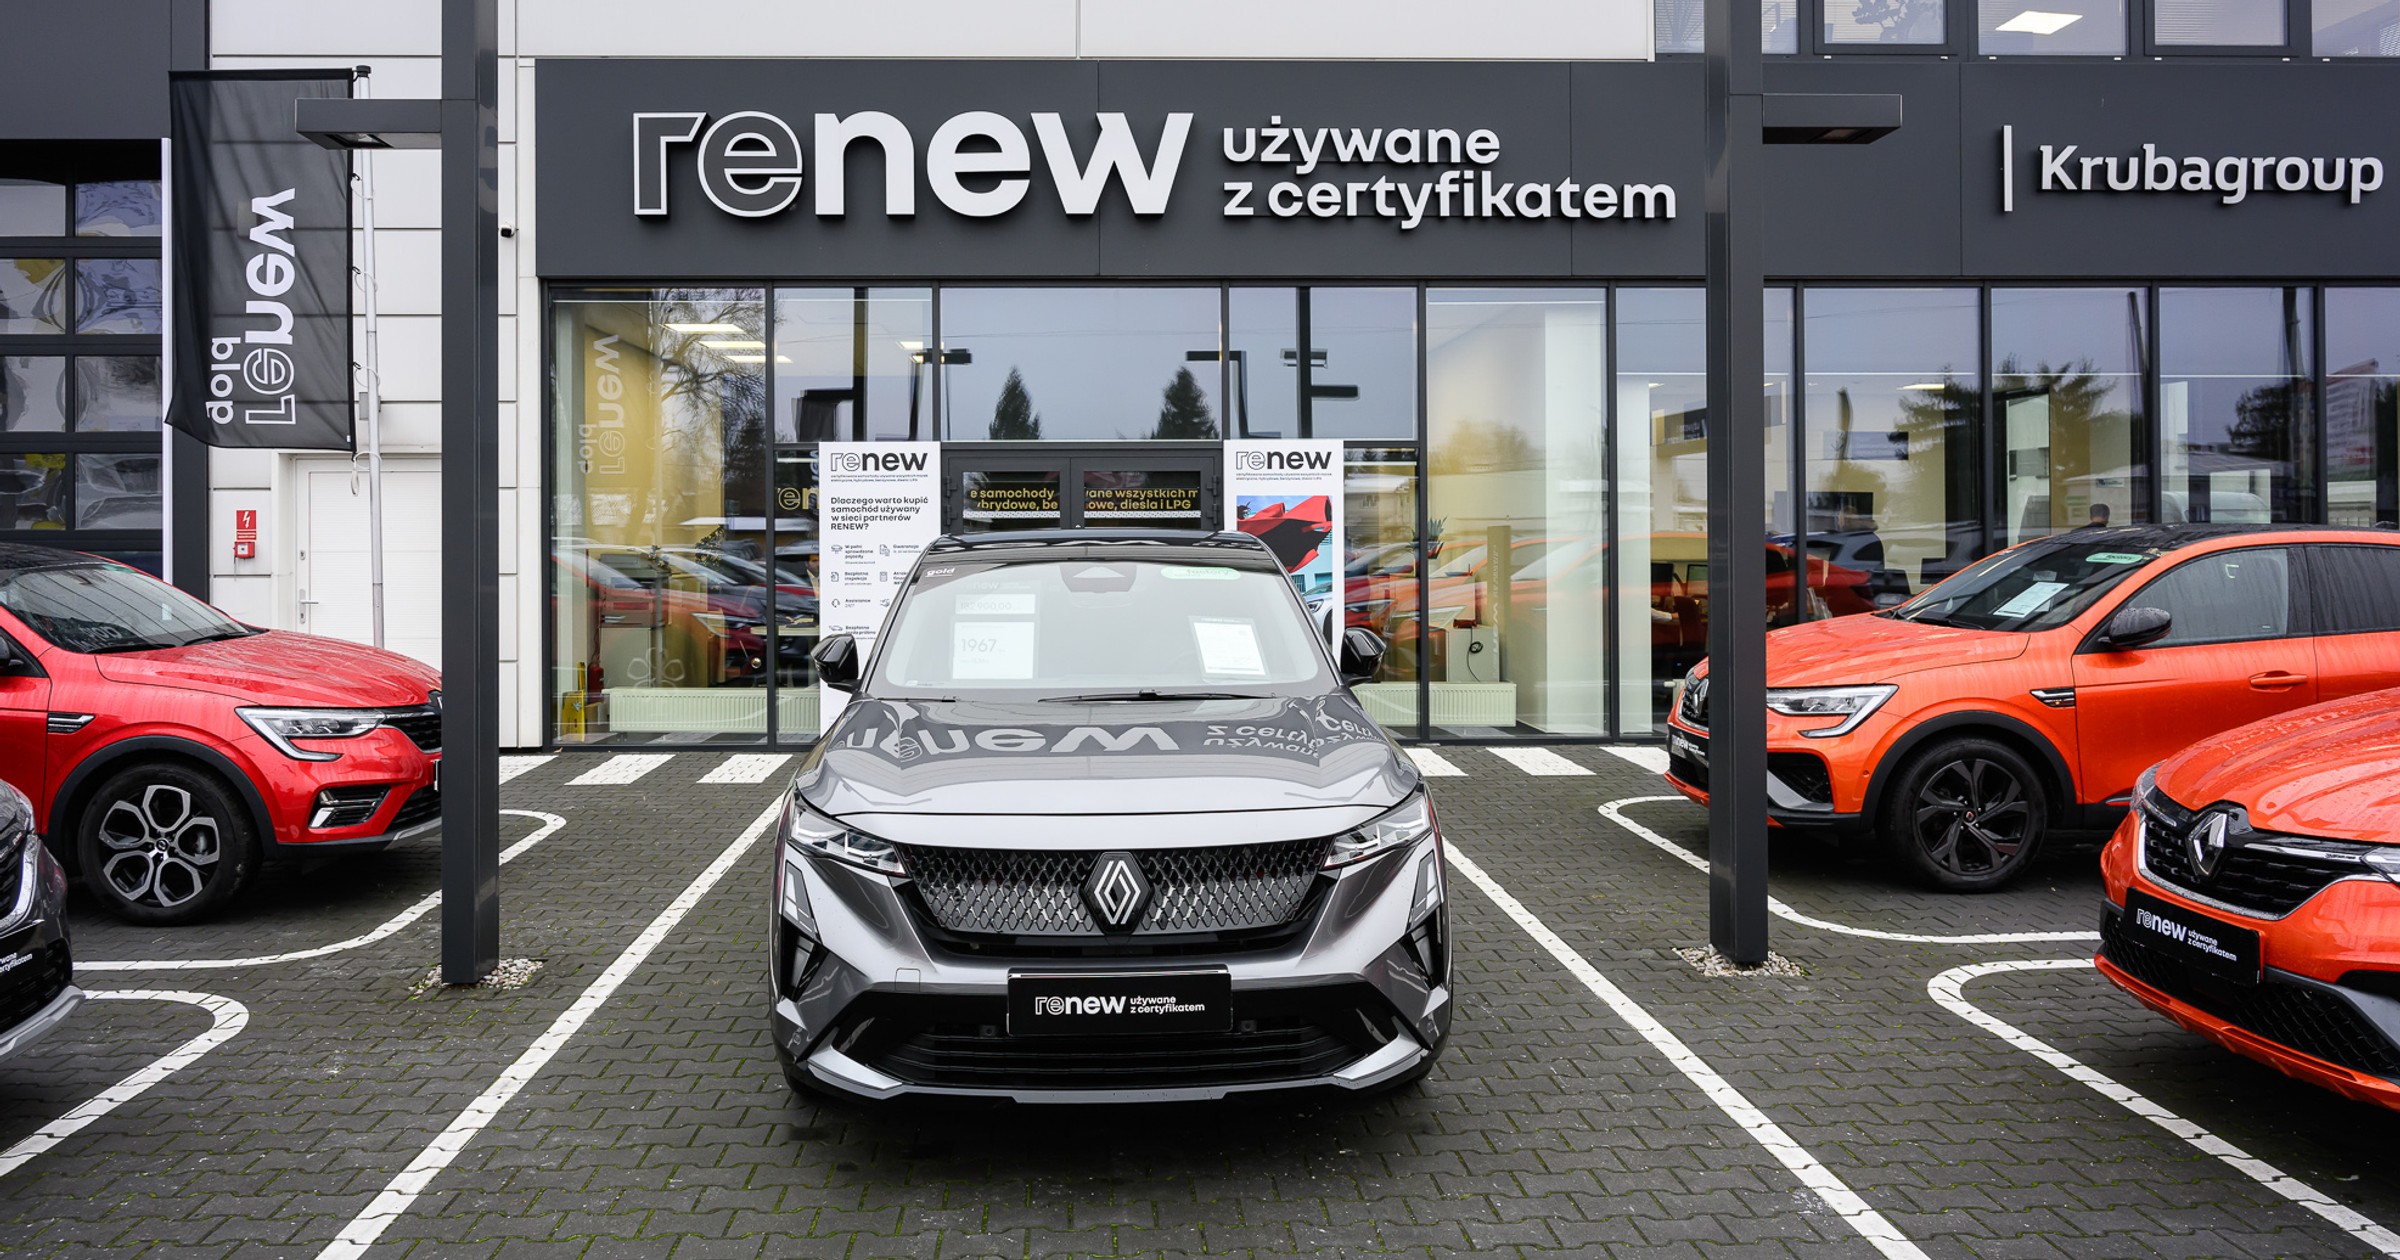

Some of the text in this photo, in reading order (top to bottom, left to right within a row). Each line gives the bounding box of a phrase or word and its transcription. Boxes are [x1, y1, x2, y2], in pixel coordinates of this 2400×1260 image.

[1223, 115, 1500, 174] używane
[633, 111, 1194, 218] renew
[2039, 143, 2385, 204] Krubagroup
[1223, 170, 1677, 229] z certyfikatem
[830, 452, 929, 471] renew
[1235, 451, 1332, 470] renew
[980, 488, 1055, 500] samochody
[1115, 489, 1186, 500] wszystkich
[830, 497, 874, 506] Dlaczego
[903, 496, 929, 506] kupić
[1120, 499, 1158, 510] diesla
[1166, 499, 1191, 510] LPG
[830, 505, 921, 515] samochód używany
[841, 513, 863, 522] sieci
[863, 513, 912, 523] partnerów
[830, 523, 869, 531] RENEW?
[925, 567, 955, 577] gold
[960, 638, 998, 652] 1967
[2136, 908, 2187, 942] renew
[1035, 996, 1126, 1015] renew
[1130, 995, 1176, 1006] używane
[1130, 1003, 1205, 1016] z certyfikatem
